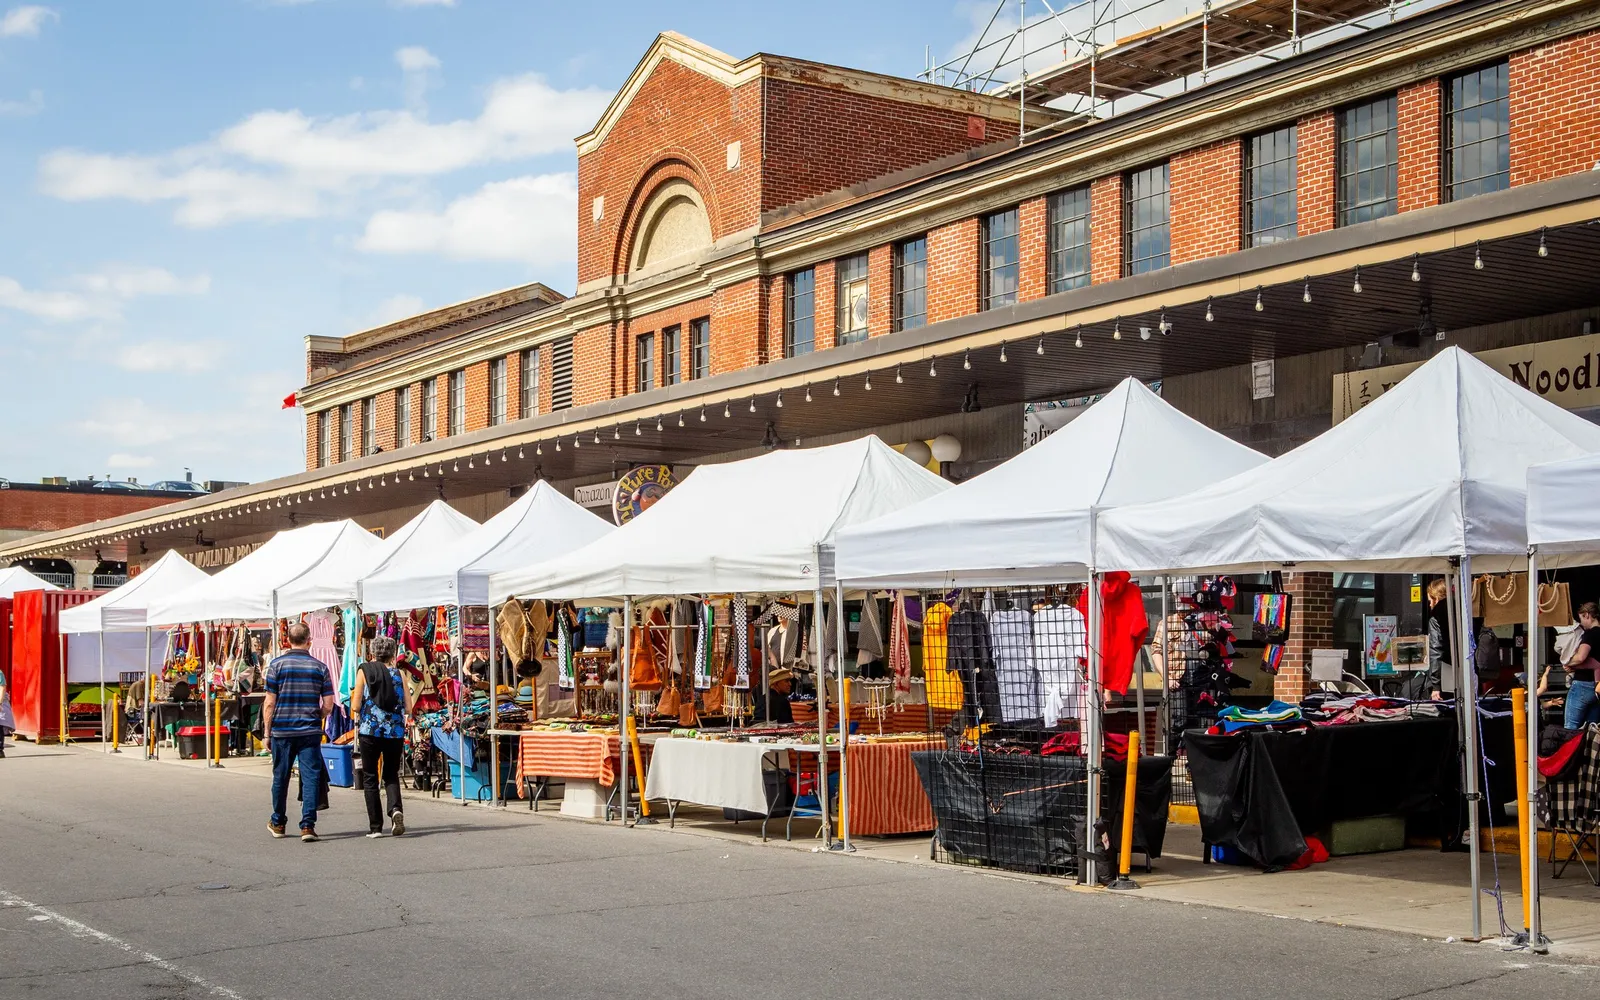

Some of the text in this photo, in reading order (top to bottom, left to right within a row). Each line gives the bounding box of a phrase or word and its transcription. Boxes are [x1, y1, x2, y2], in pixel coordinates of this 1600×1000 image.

[620, 467, 654, 493] Pure
[195, 548, 223, 568] MOULIN
[224, 546, 235, 565] DE
